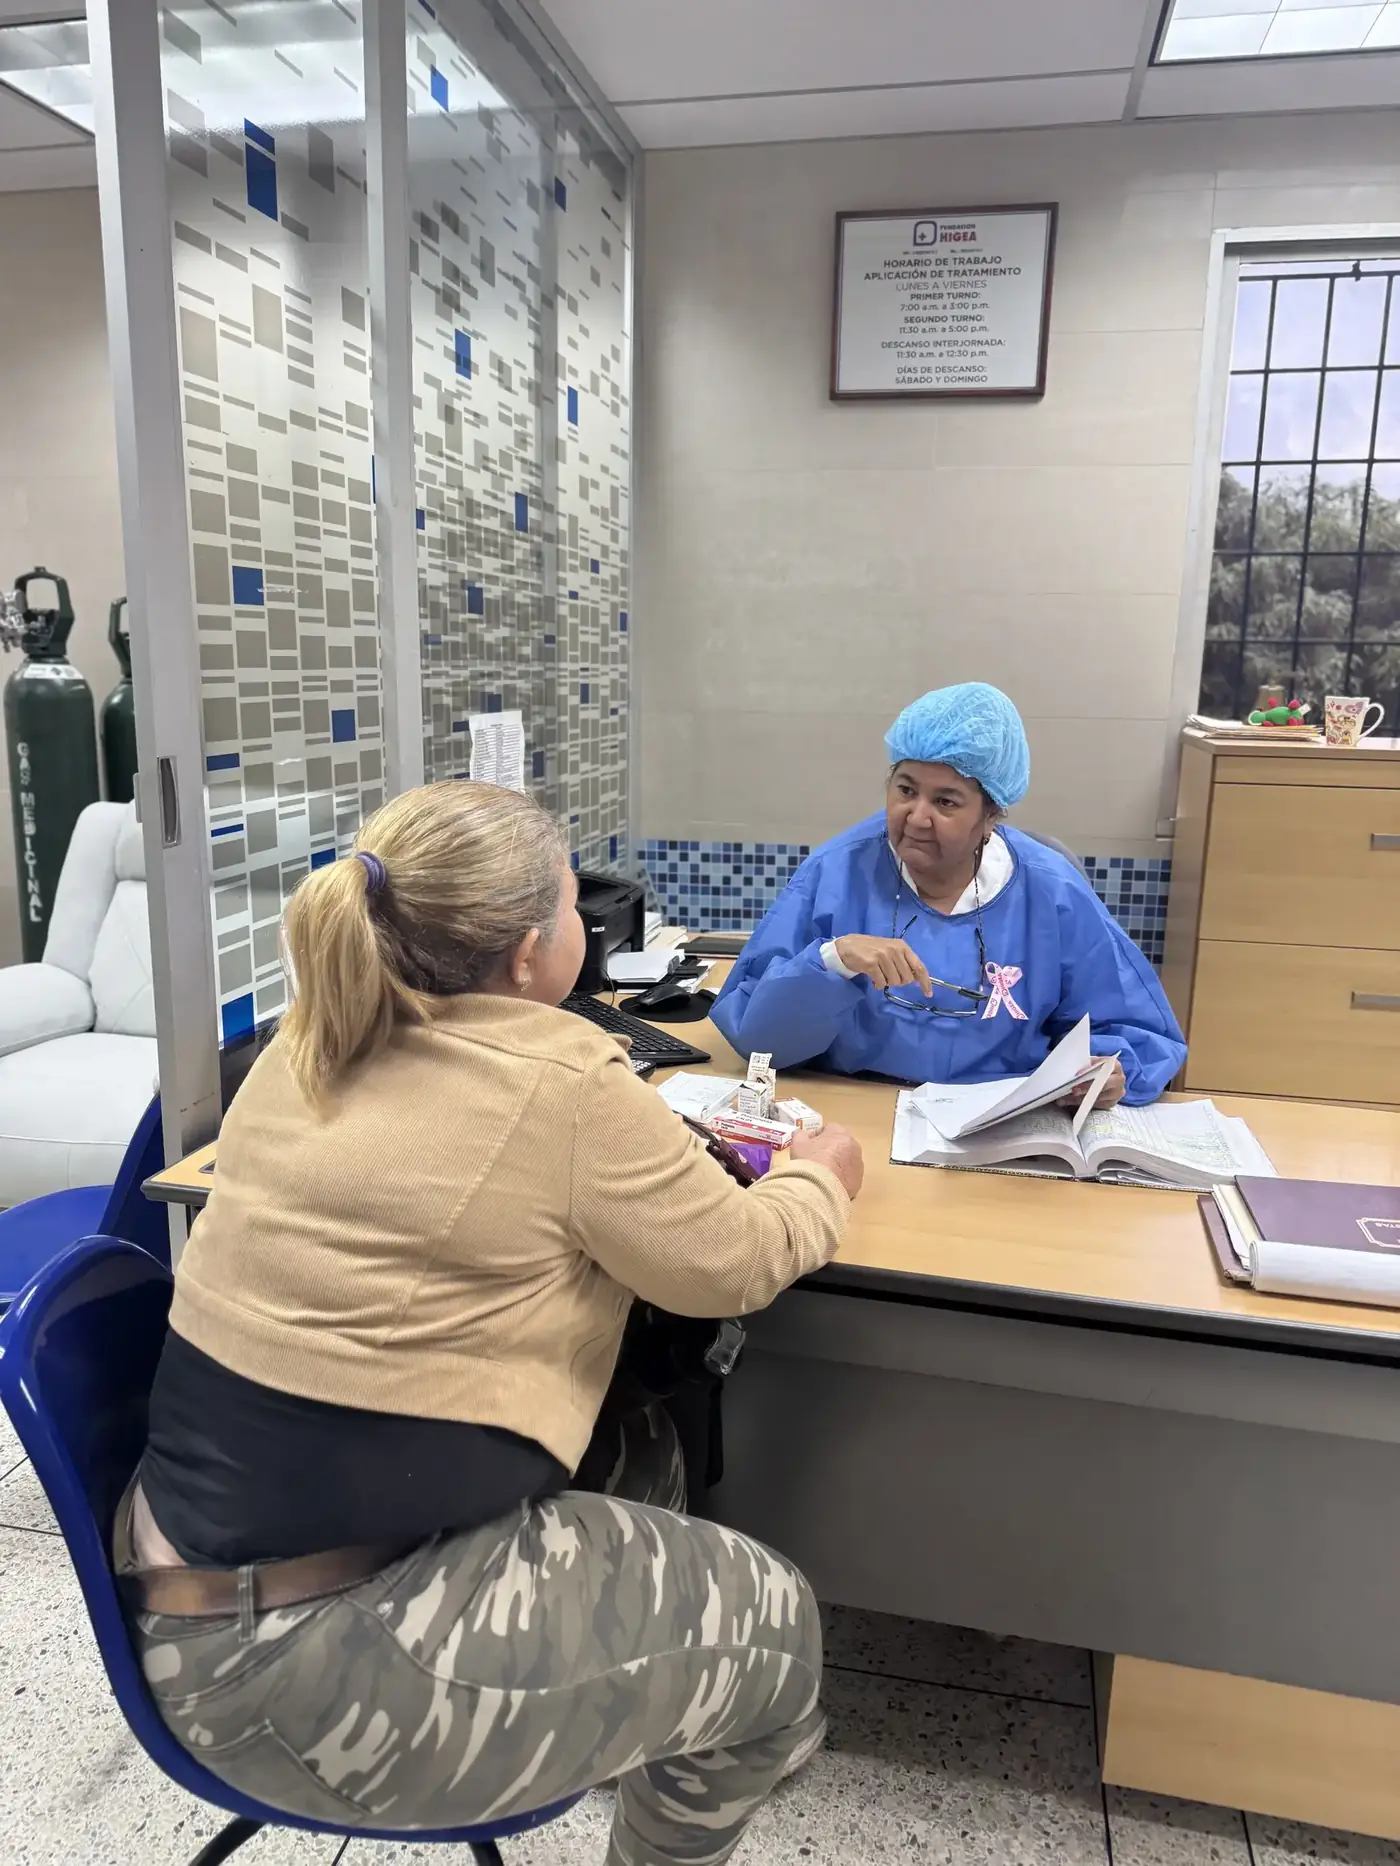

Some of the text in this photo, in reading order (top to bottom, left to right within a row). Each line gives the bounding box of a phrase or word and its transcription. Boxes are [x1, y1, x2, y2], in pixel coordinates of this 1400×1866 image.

[940, 232, 977, 242] HIGEA
[884, 256, 1002, 268] HORARIO DE TRABAJO
[864, 268, 1021, 280] APLICACIÓN DE TRATAMIENTO
[896, 282, 929, 291] LUNES
[942, 280, 987, 289] VIERNES
[900, 303, 920, 311] 7:00
[949, 302, 969, 310] 3:00
[904, 316, 948, 324] SEGUNDO
[900, 326, 919, 334] 11:30
[949, 325, 968, 333] 5:00
[971, 326, 989, 334] p.m.
[882, 339, 1005, 349] DESCANSO INTERJORNADA:
[897, 350, 916, 358] 11:30
[946, 349, 968, 357] 12:30
[970, 350, 989, 358] p.m.
[897, 365, 917, 374] DÍAS
[895, 375, 933, 384] SÁBADO
[944, 375, 988, 383] DOMINGO
[17, 742, 43, 922] GAS MEDICINAL
